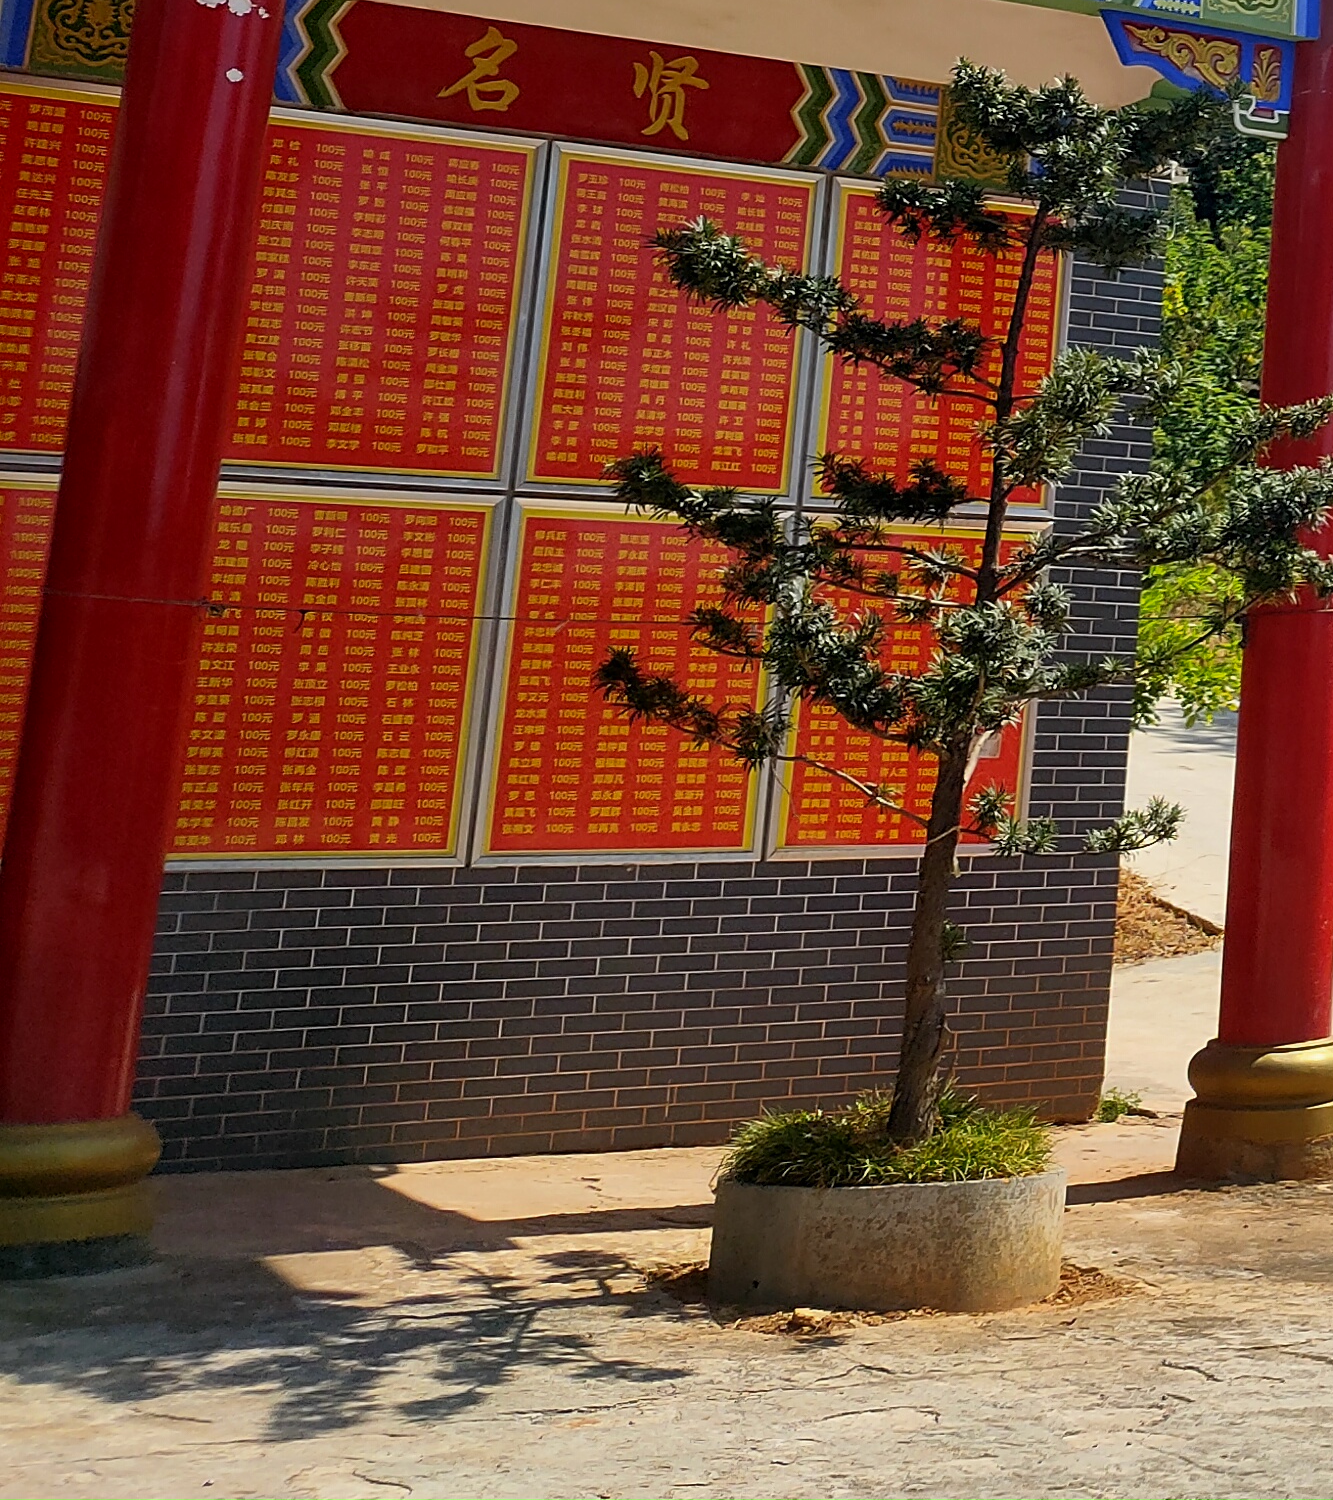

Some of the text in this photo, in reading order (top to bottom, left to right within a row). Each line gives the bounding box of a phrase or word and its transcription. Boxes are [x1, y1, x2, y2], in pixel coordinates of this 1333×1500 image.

[80, 110, 113, 123] 100元
[75, 143, 108, 156] 100元
[405, 154, 434, 164] 100元
[314, 160, 343, 170] 100元
[403, 169, 431, 180] 100元
[70, 176, 103, 190] 100元
[312, 176, 342, 186] 100元
[401, 185, 431, 195] 100元
[619, 178, 645, 188] 100元
[700, 188, 725, 197] 100元
[777, 197, 802, 206] 100元
[615, 208, 642, 218] 100元
[396, 232, 425, 242] 100元
[483, 241, 511, 251] 100元
[961, 260, 985, 272] 100元
[888, 267, 912, 279] 100元
[960, 274, 984, 286] 100元
[478, 288, 506, 297] 100元
[607, 284, 634, 293] 100元
[606, 299, 633, 309] 100元
[1028, 296, 1051, 307] 100元
[604, 314, 631, 324] 100元
[686, 322, 712, 331] 100元
[1026, 324, 1048, 334] 100元
[763, 344, 788, 352] 100元
[601, 345, 628, 355] 100元
[762, 358, 787, 367] 100元
[380, 377, 409, 386] 100元
[597, 376, 625, 385] 100元
[378, 393, 407, 402] 100元
[595, 392, 624, 401] 100元
[679, 398, 705, 406] 100元
[284, 403, 315, 413] 100元
[463, 415, 492, 424] 100元
[876, 412, 900, 423] 100元
[677, 413, 703, 422] 100元
[756, 419, 780, 427] 100元
[675, 428, 701, 437] 100元
[372, 442, 401, 451] 100元
[460, 447, 489, 456] 100元
[751, 464, 776, 473] 100元
[267, 508, 298, 517] 100元
[449, 517, 478, 527] 100元
[358, 529, 388, 538] 100元
[659, 552, 686, 561] 100元
[261, 559, 292, 568] 100元
[354, 563, 384, 572] 100元
[443, 567, 472, 575] 100元
[573, 564, 602, 573] 100元
[258, 576, 290, 585] 100元
[352, 579, 382, 588] 100元
[573, 580, 600, 589] 100元
[656, 584, 682, 592] 100元
[250, 644, 281, 653] 100元
[434, 649, 462, 657] 100元
[342, 663, 372, 672] 100元
[432, 666, 461, 674] 100元
[245, 678, 277, 687] 100元
[339, 680, 370, 689] 100元
[430, 682, 459, 690] 100元
[428, 699, 457, 707] 100元
[424, 732, 453, 740] 100元
[846, 736, 871, 746] 100元
[553, 758, 582, 766] 100元
[420, 766, 449, 774] 100元
[327, 783, 357, 791] 100元
[325, 800, 355, 808] 100元
[839, 799, 864, 808] 100元
[323, 817, 353, 826] 100元
[838, 814, 862, 823] 100元
[712, 822, 738, 830] 100元
[320, 834, 351, 842] 100元
[412, 833, 441, 841] 100元
[836, 830, 860, 839] 100元
